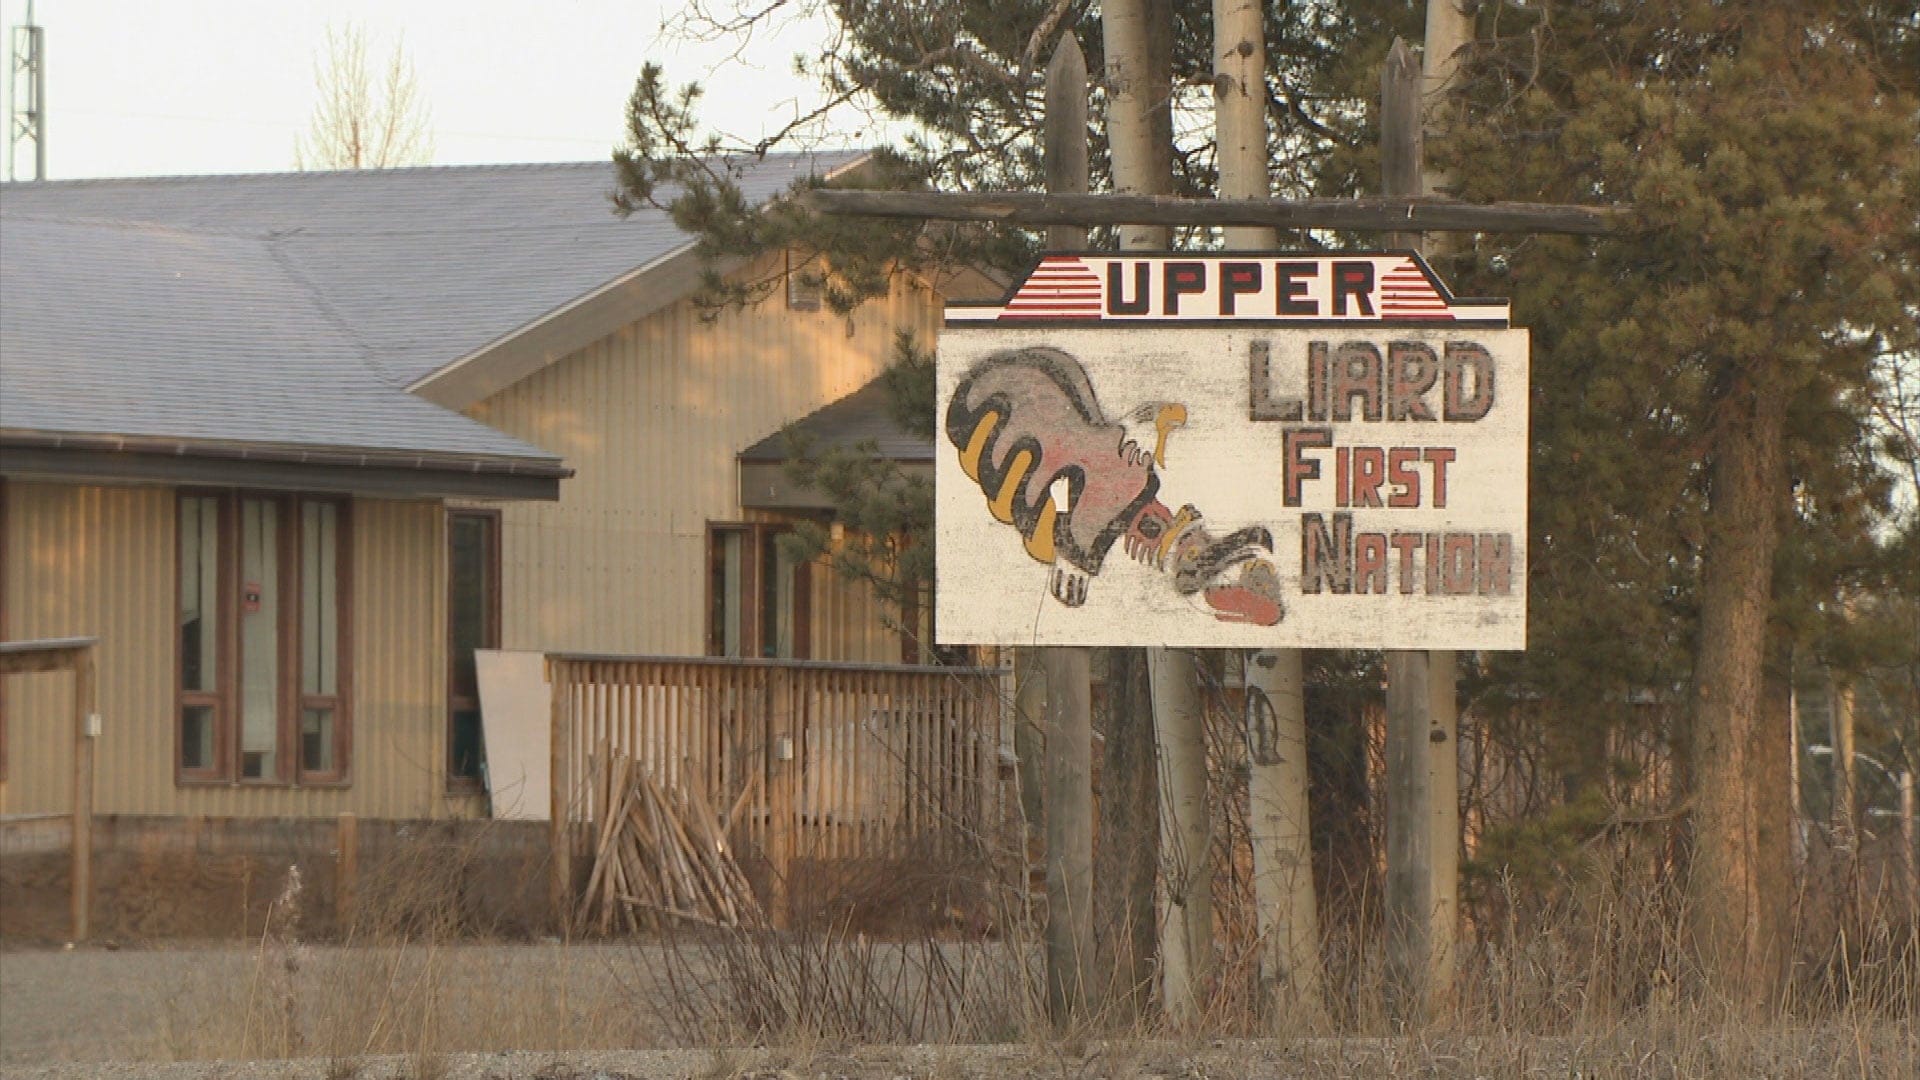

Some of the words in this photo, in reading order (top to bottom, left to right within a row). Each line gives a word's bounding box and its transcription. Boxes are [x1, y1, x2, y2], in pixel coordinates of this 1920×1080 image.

[1105, 261, 1376, 317] UPPER
[1249, 340, 1496, 422] LIARD
[1282, 427, 1457, 508] FIRST
[1301, 512, 1512, 596] NATION
